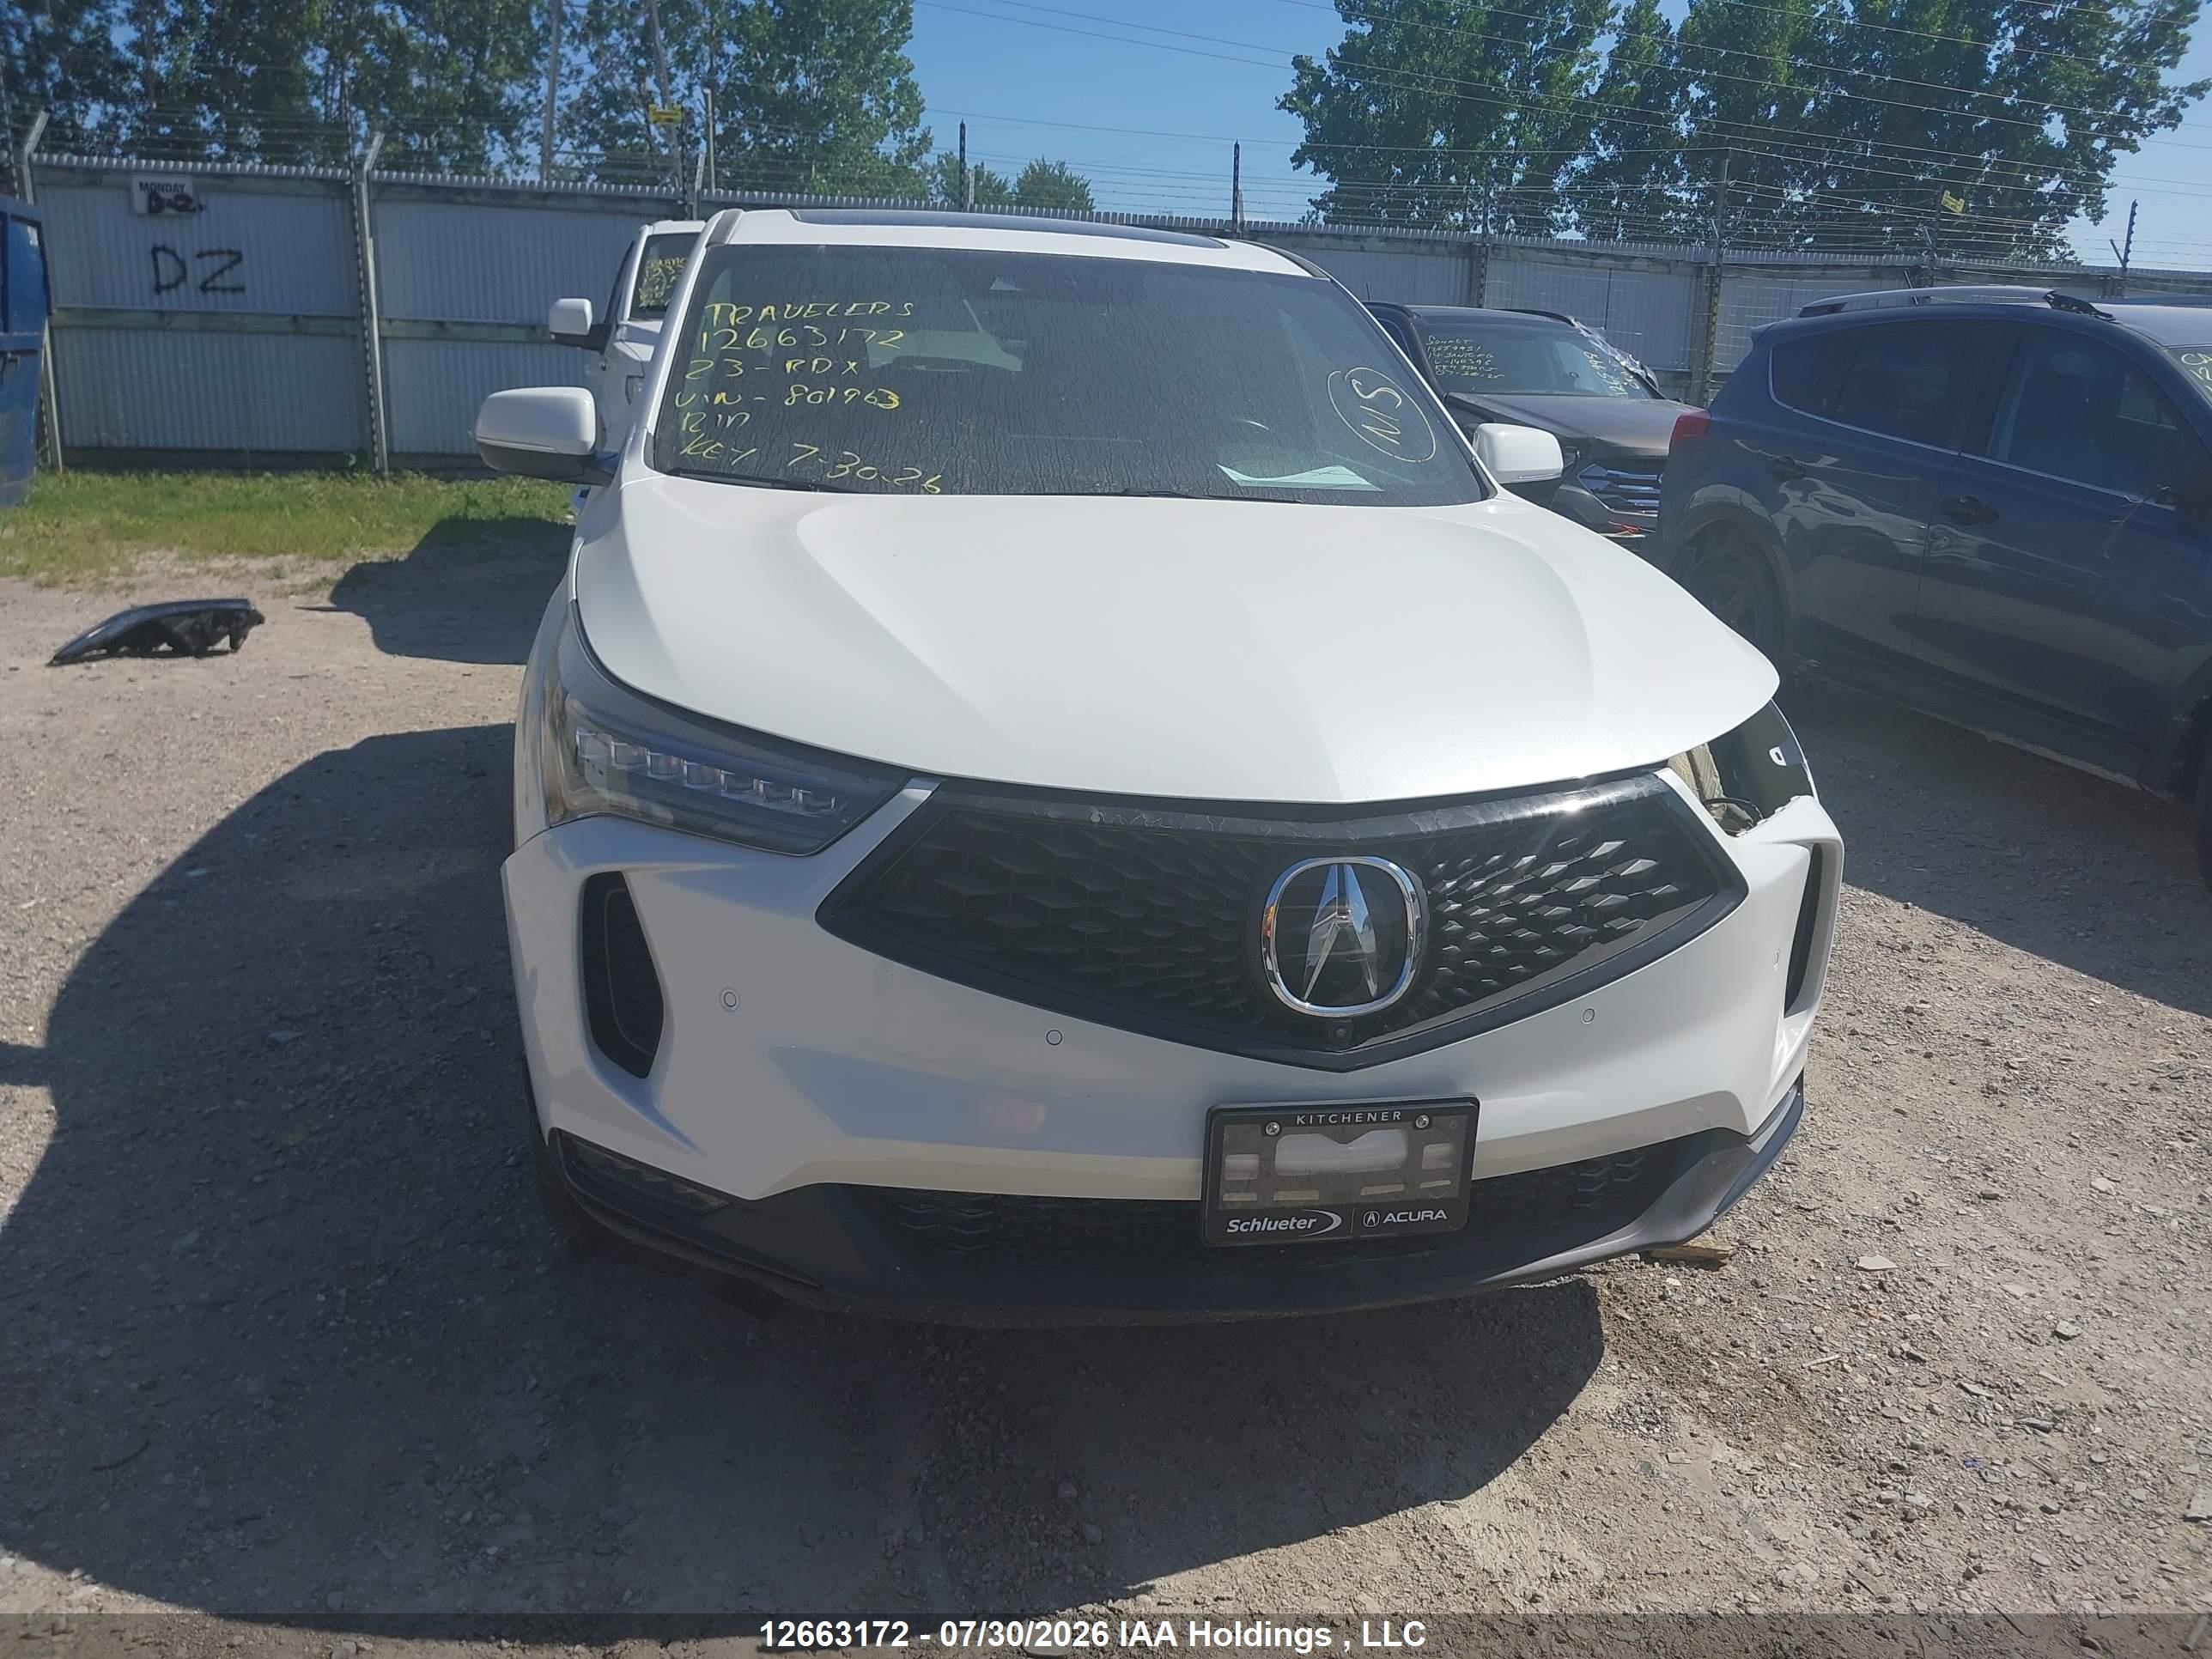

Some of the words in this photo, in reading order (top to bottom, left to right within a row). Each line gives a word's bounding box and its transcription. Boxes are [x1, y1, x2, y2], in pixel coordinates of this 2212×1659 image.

[139, 181, 186, 193] MONDAY
[705, 302, 914, 326] TRAVELERS
[702, 325, 904, 352] 12663172
[679, 432, 757, 465] KEY
[1296, 1110, 1402, 1126] KITCHENER
[1226, 1216, 1317, 1233] Schlueter
[1382, 1209, 1448, 1224] ACURA
